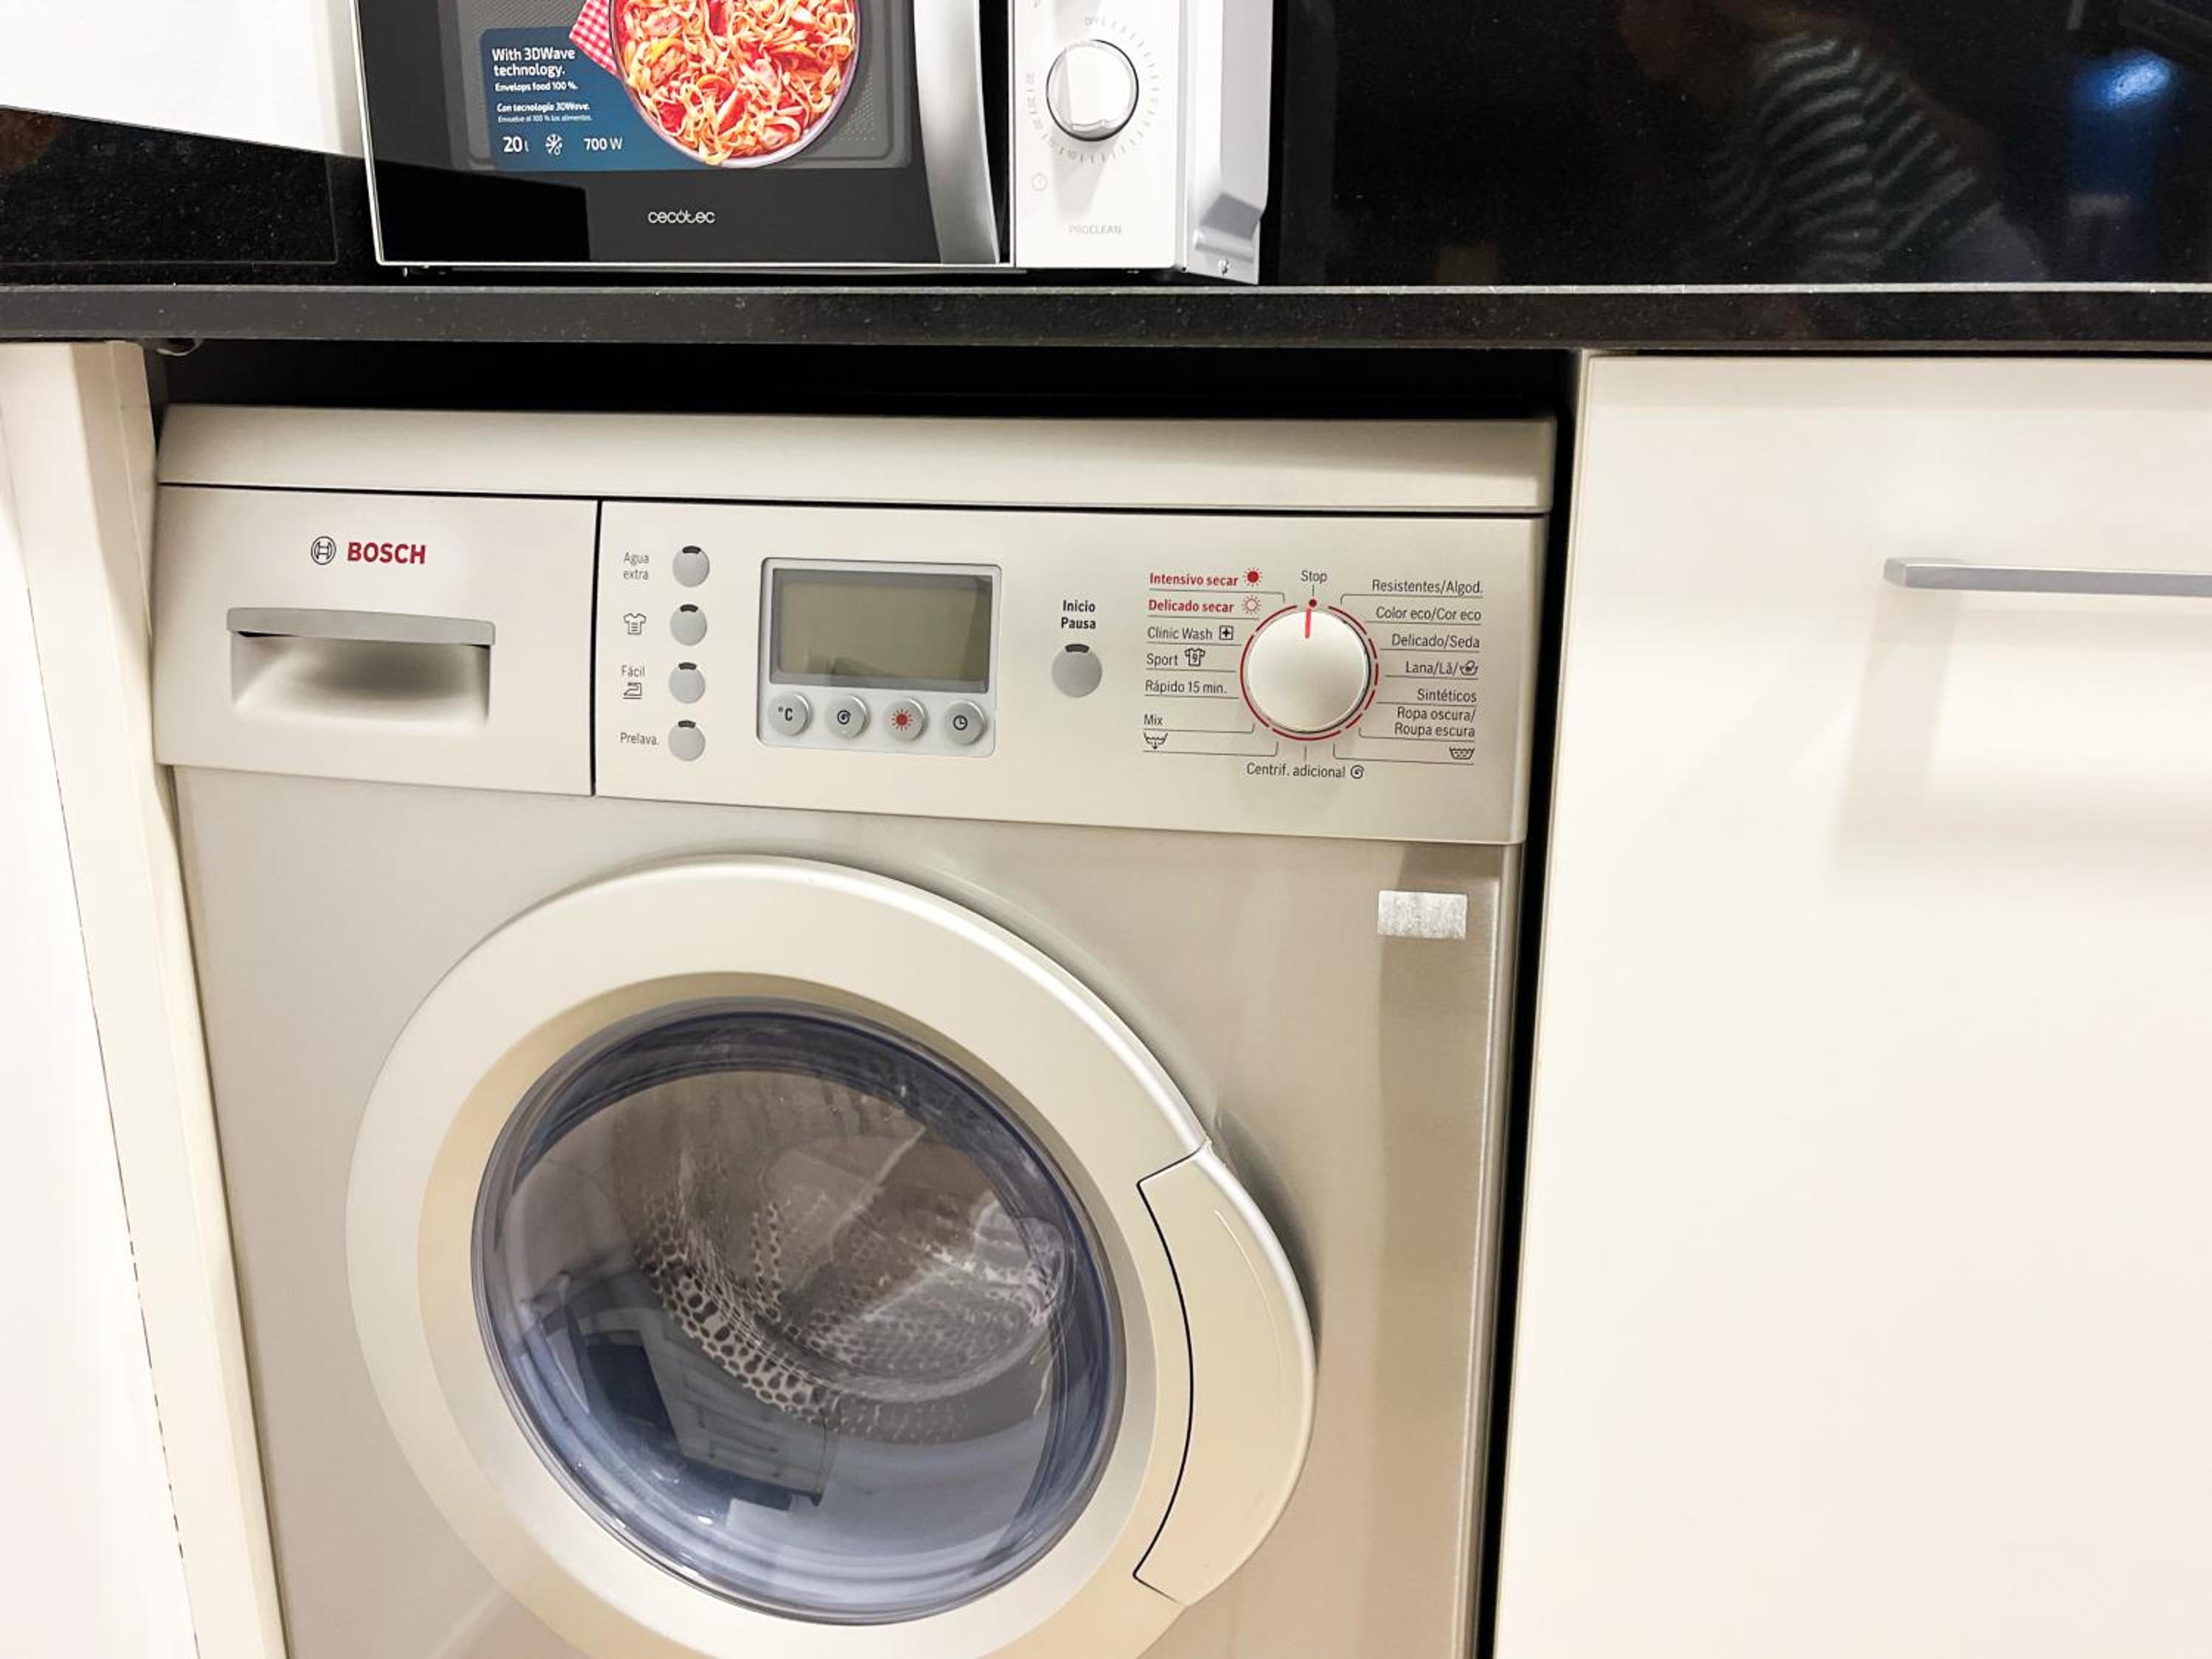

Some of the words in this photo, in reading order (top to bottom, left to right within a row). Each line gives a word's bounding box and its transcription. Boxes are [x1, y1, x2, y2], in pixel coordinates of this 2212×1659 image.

[492, 48, 521, 61] With
[524, 46, 576, 60] 3DWave
[493, 63, 566, 79] technology.
[532, 83, 551, 91] food
[552, 81, 567, 90] 100
[496, 102, 512, 113] Con
[503, 136, 523, 153] 20
[583, 137, 608, 151] 700
[609, 137, 623, 150] W
[347, 542, 425, 565] BOSCH
[623, 552, 650, 566] Agua
[623, 569, 649, 580] extra
[1150, 572, 1204, 586] Intensivo
[1206, 577, 1239, 586] secar
[1301, 570, 1328, 584] Stop
[1371, 579, 1484, 597] Resistentes/Algod.
[1062, 599, 1096, 613] Inicio
[1148, 599, 1200, 611] Delicado
[1203, 603, 1234, 613] secar
[1375, 605, 1408, 619] Color
[1410, 607, 1457, 622] eco/Cor
[1460, 611, 1482, 621] eco
[1061, 616, 1096, 630] Pausa
[1147, 626, 1179, 639] Clinic
[1181, 627, 1213, 640] Wash
[1391, 633, 1481, 649] Delicado/Seda
[1147, 653, 1178, 667] Sport
[621, 664, 645, 678] Fácil
[1145, 680, 1185, 693] Rápido
[1188, 681, 1200, 693] 15
[1203, 683, 1228, 694] min.
[1416, 688, 1478, 703] Sintéticos
[1144, 714, 1163, 726] Mix
[1397, 706, 1427, 721] Ropa
[1430, 708, 1476, 723] oscura/
[1394, 722, 1433, 737] Roupa
[1435, 726, 1475, 737] escura
[1247, 762, 1290, 776] Centrif.
[1293, 764, 1346, 778] adicional
